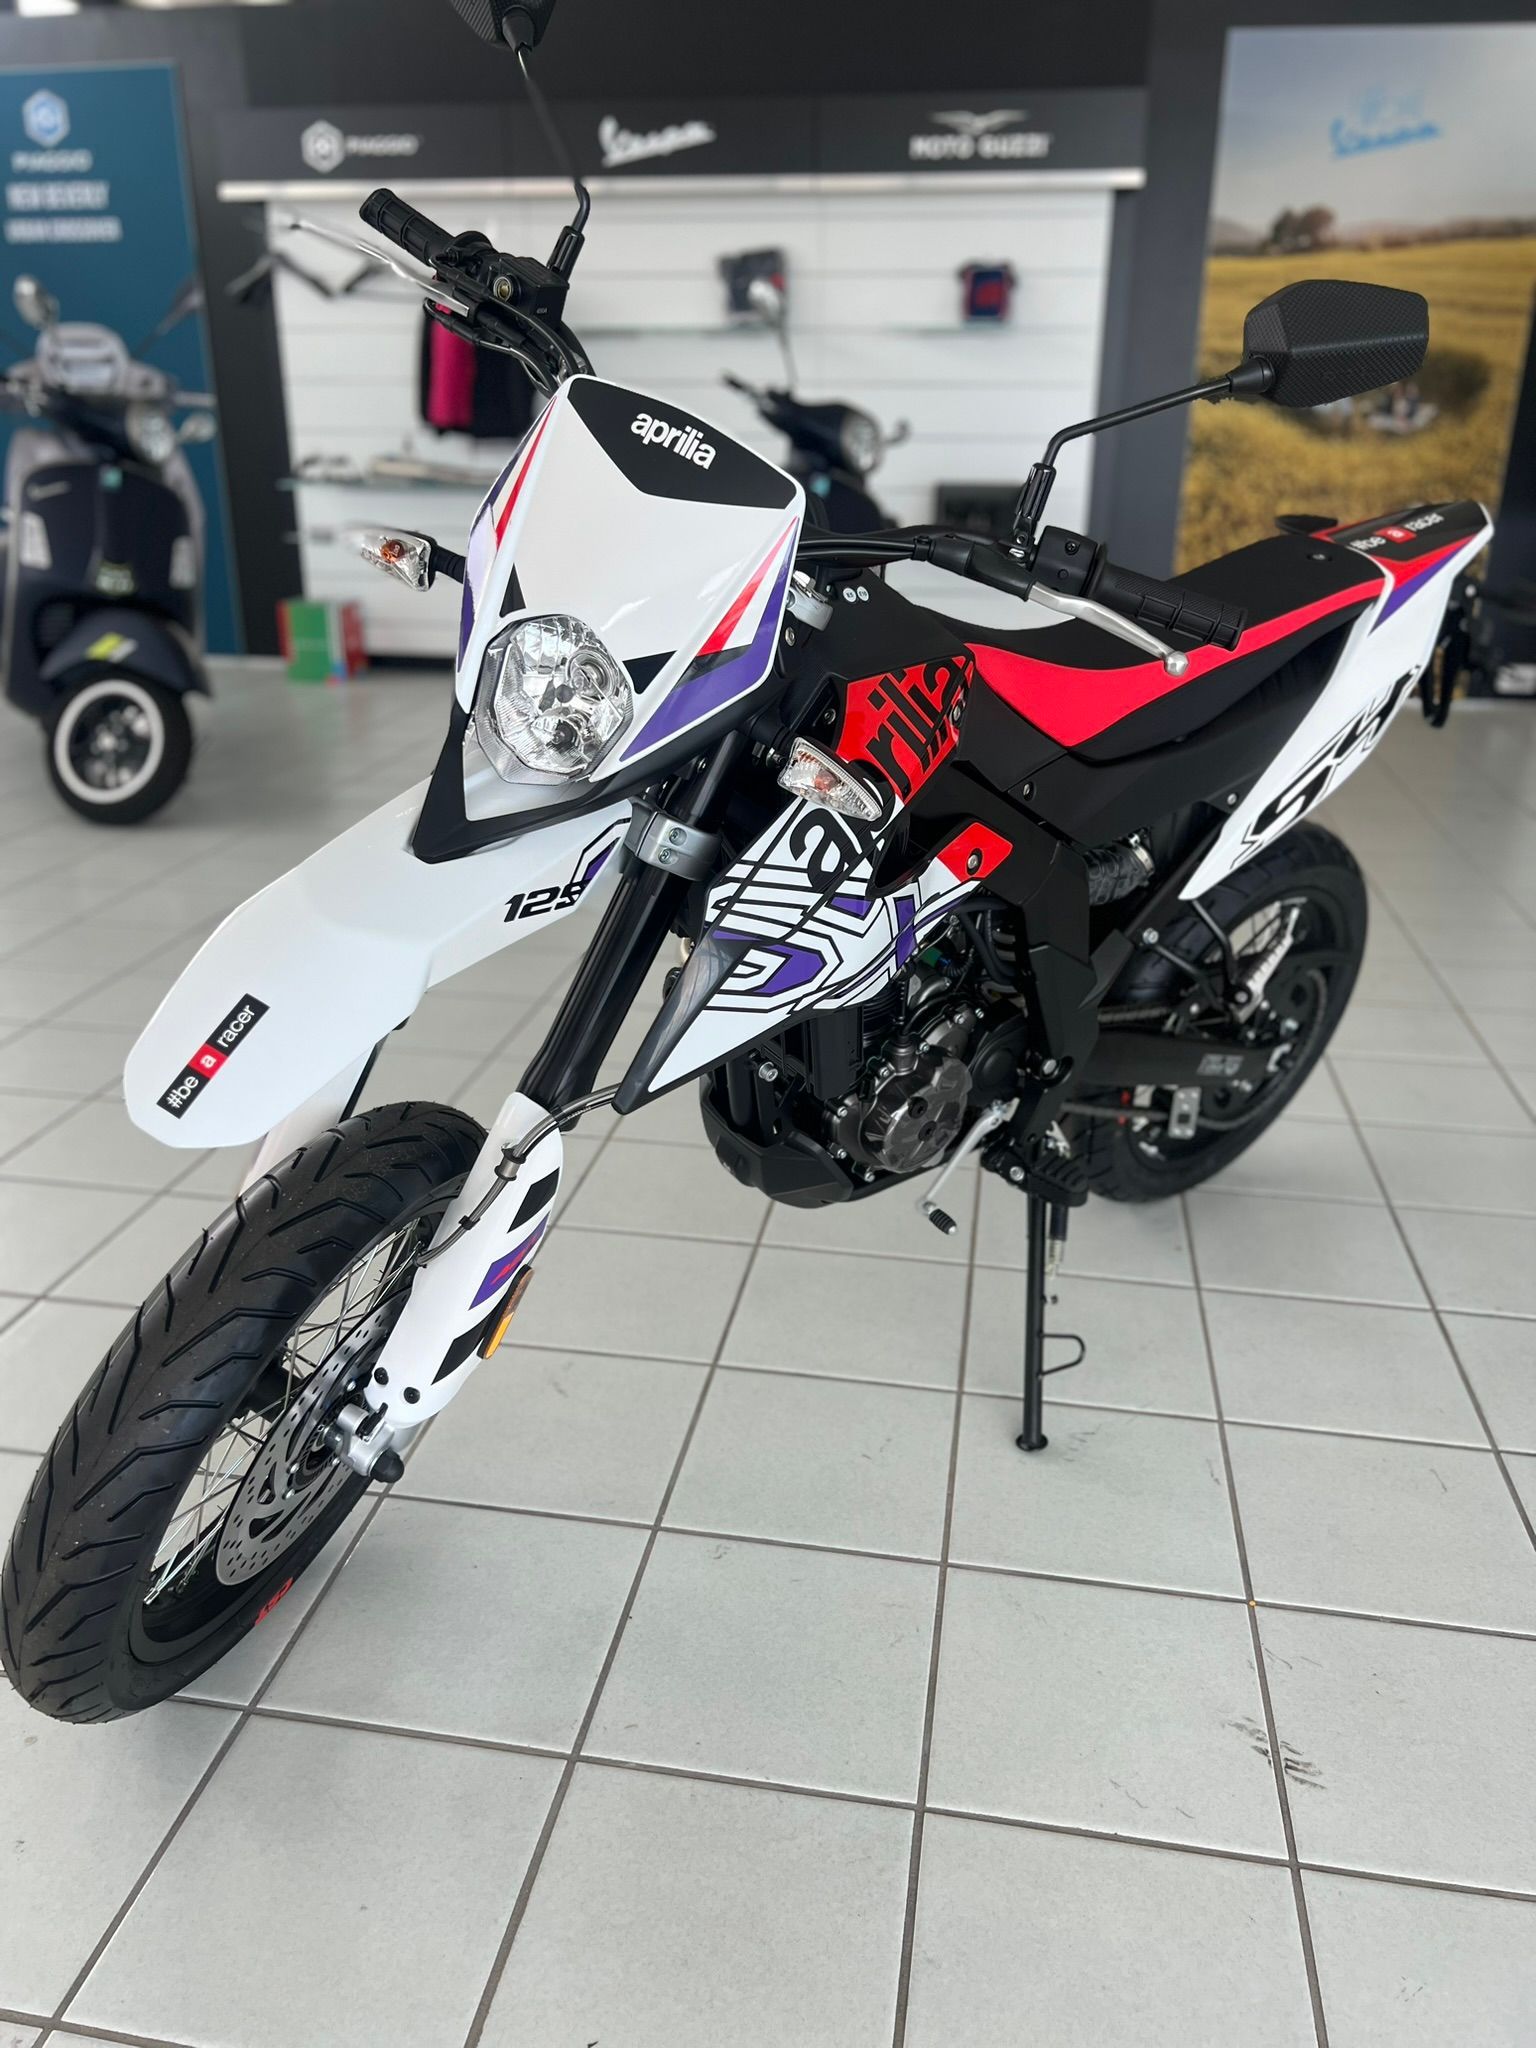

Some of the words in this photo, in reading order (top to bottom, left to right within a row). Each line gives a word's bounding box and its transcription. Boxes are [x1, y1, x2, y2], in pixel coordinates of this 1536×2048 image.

[599, 115, 717, 168] Vespa
[910, 134, 974, 160] MOTO
[977, 132, 1049, 158] GUZZI
[630, 412, 717, 470] aprilia
[1403, 512, 1445, 532] racer
[503, 880, 588, 922] 125
[166, 1075, 199, 1109] #be
[200, 1054, 217, 1069] a
[216, 1004, 255, 1048] racer
